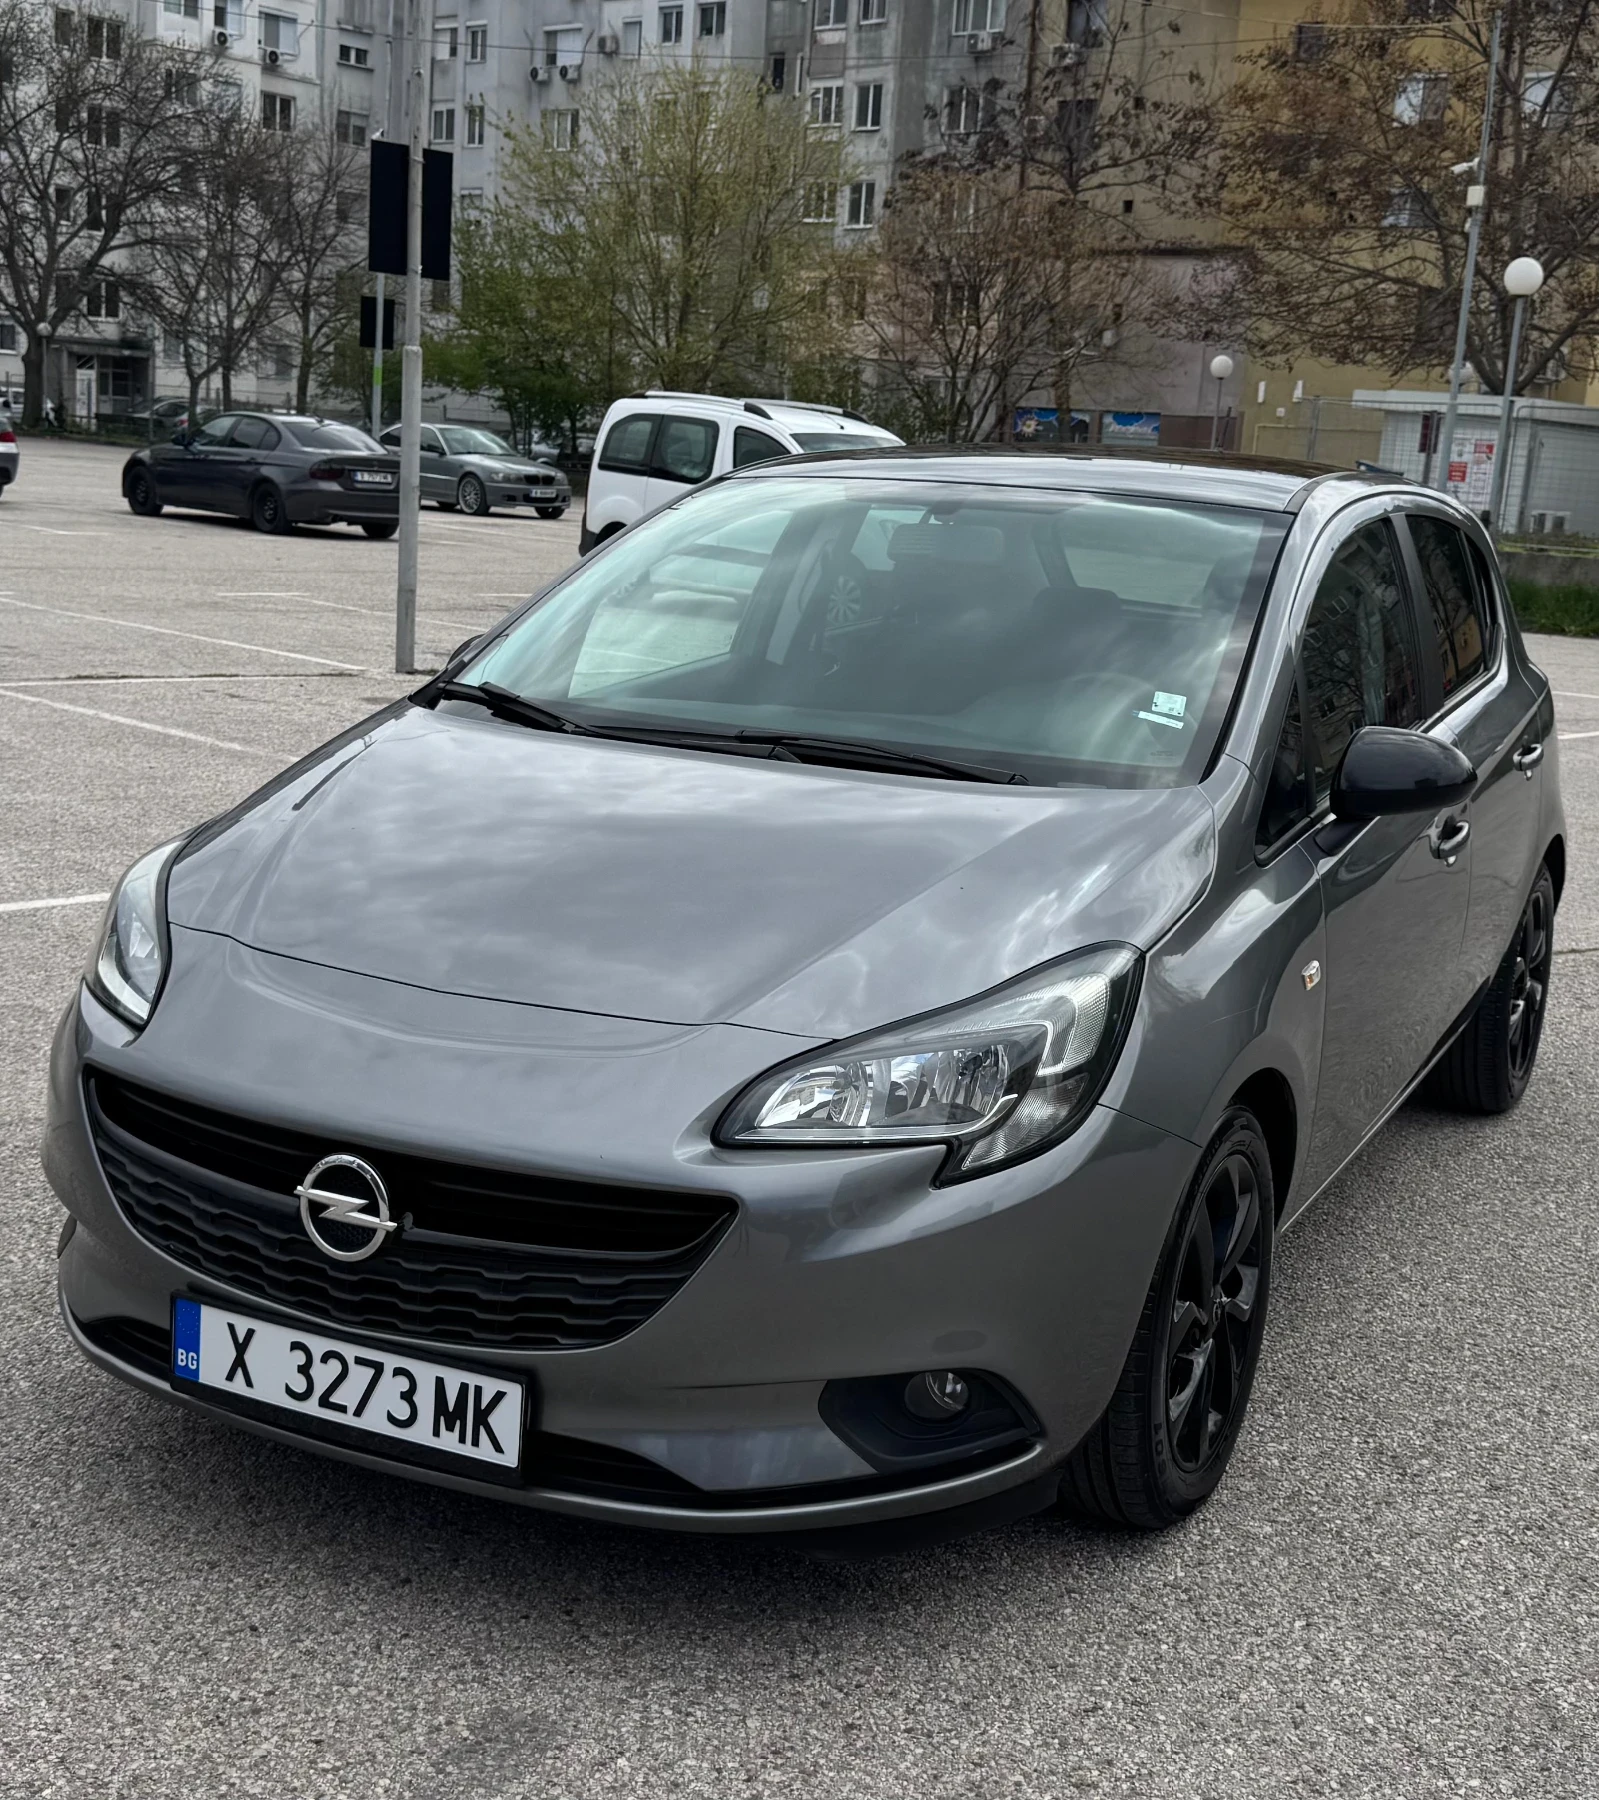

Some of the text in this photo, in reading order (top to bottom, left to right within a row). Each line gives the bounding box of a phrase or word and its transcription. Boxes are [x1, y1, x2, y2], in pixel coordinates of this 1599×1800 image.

[177, 1348, 198, 1370] BG
[225, 1322, 508, 1454] X 3273 MK
